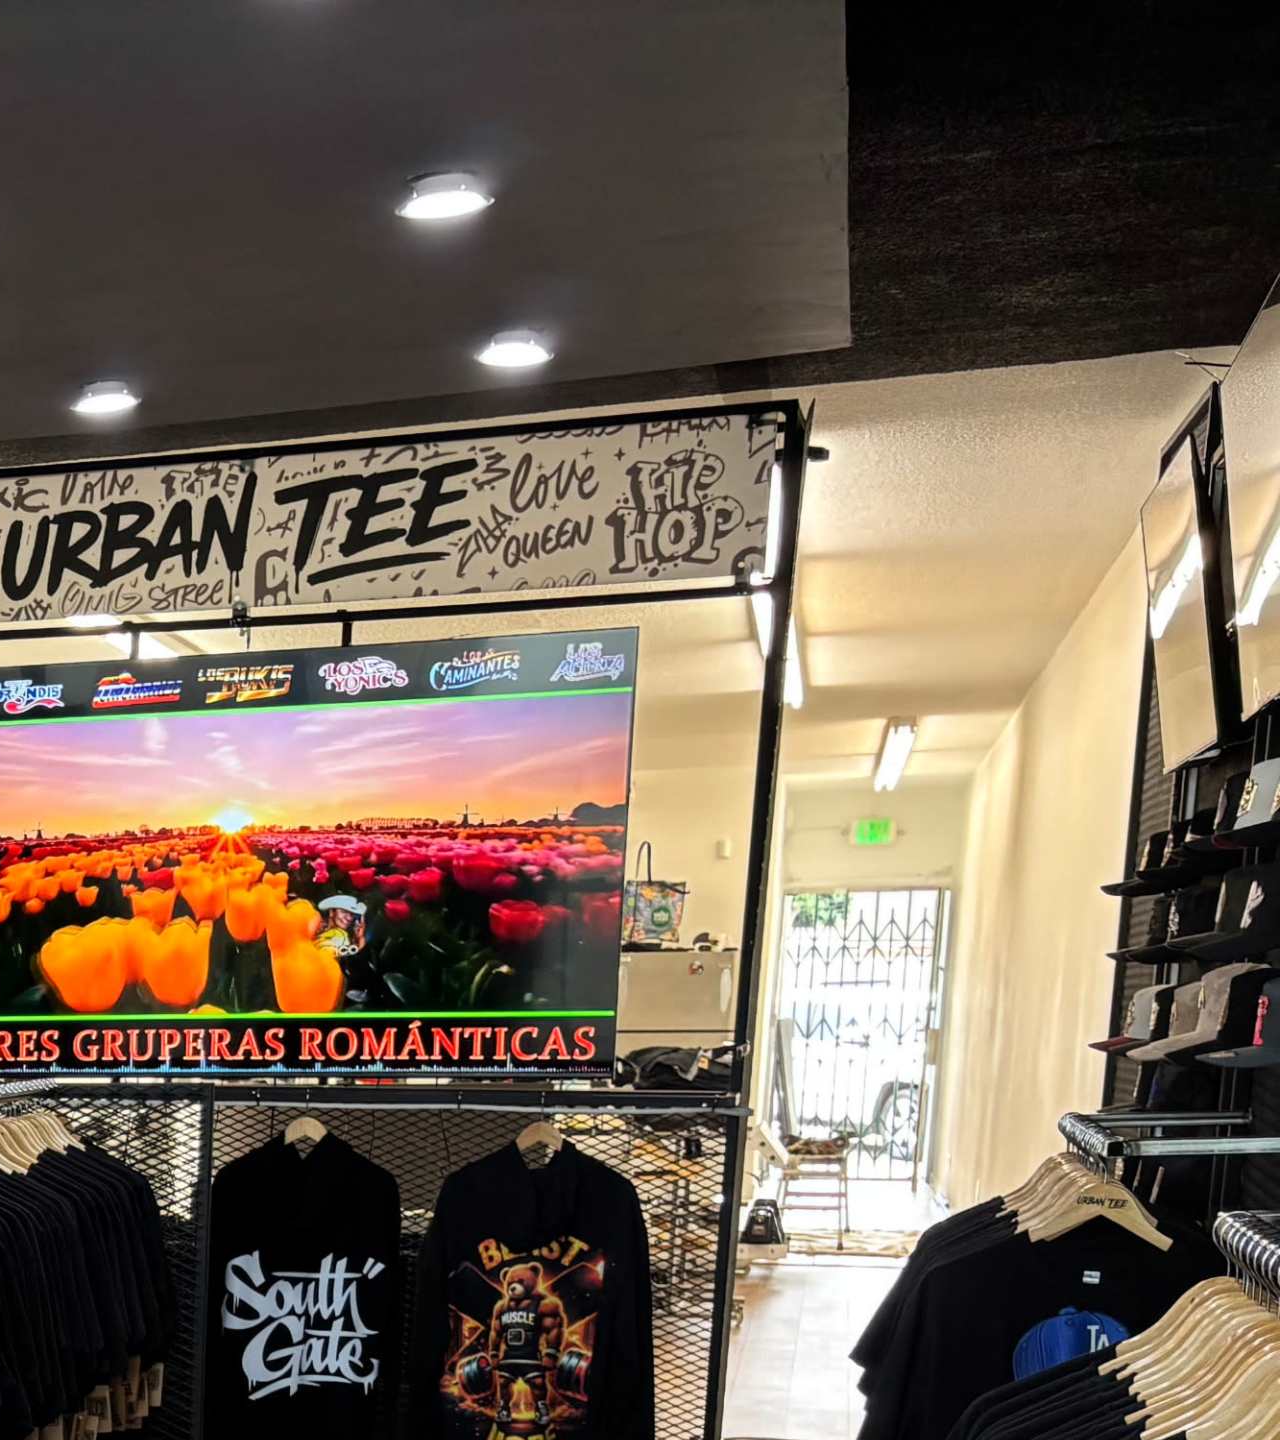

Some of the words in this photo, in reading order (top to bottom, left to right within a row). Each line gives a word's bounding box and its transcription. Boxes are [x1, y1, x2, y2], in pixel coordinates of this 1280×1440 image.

[625, 449, 726, 512] HIP
[1, 471, 257, 600] URBAN
[275, 456, 478, 577] TEE
[503, 514, 594, 567] QUEEN
[605, 496, 744, 574] HOP
[320, 659, 363, 678] LOS
[429, 653, 521, 690] CAMINANTES
[73, 1027, 286, 1062] GRUPERAS
[298, 1020, 597, 1061] ROMÁNTICAS
[221, 1250, 382, 1335] South
[241, 1314, 381, 1400] Gate
